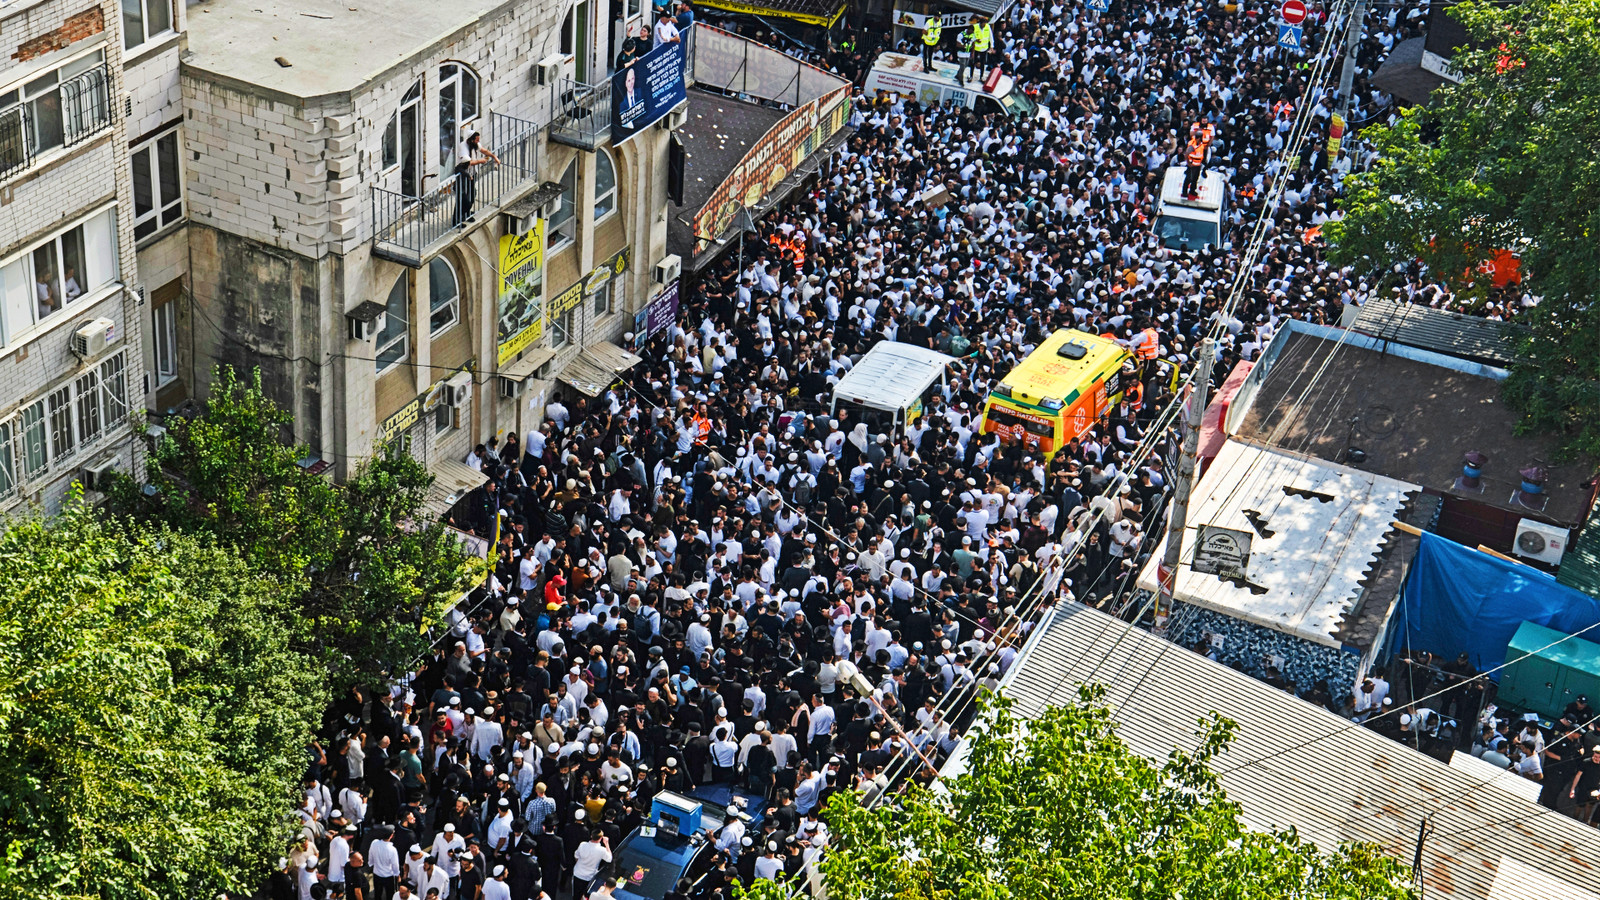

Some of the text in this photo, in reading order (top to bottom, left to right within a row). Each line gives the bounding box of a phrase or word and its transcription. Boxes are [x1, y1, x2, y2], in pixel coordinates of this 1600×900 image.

[925, 14, 967, 27] uits
[777, 108, 810, 150] המאפה
[744, 140, 774, 180] הנאמן
[504, 256, 537, 292] POYEHALI
[386, 399, 419, 430] מסעדת
[995, 404, 1016, 416] UNITED
